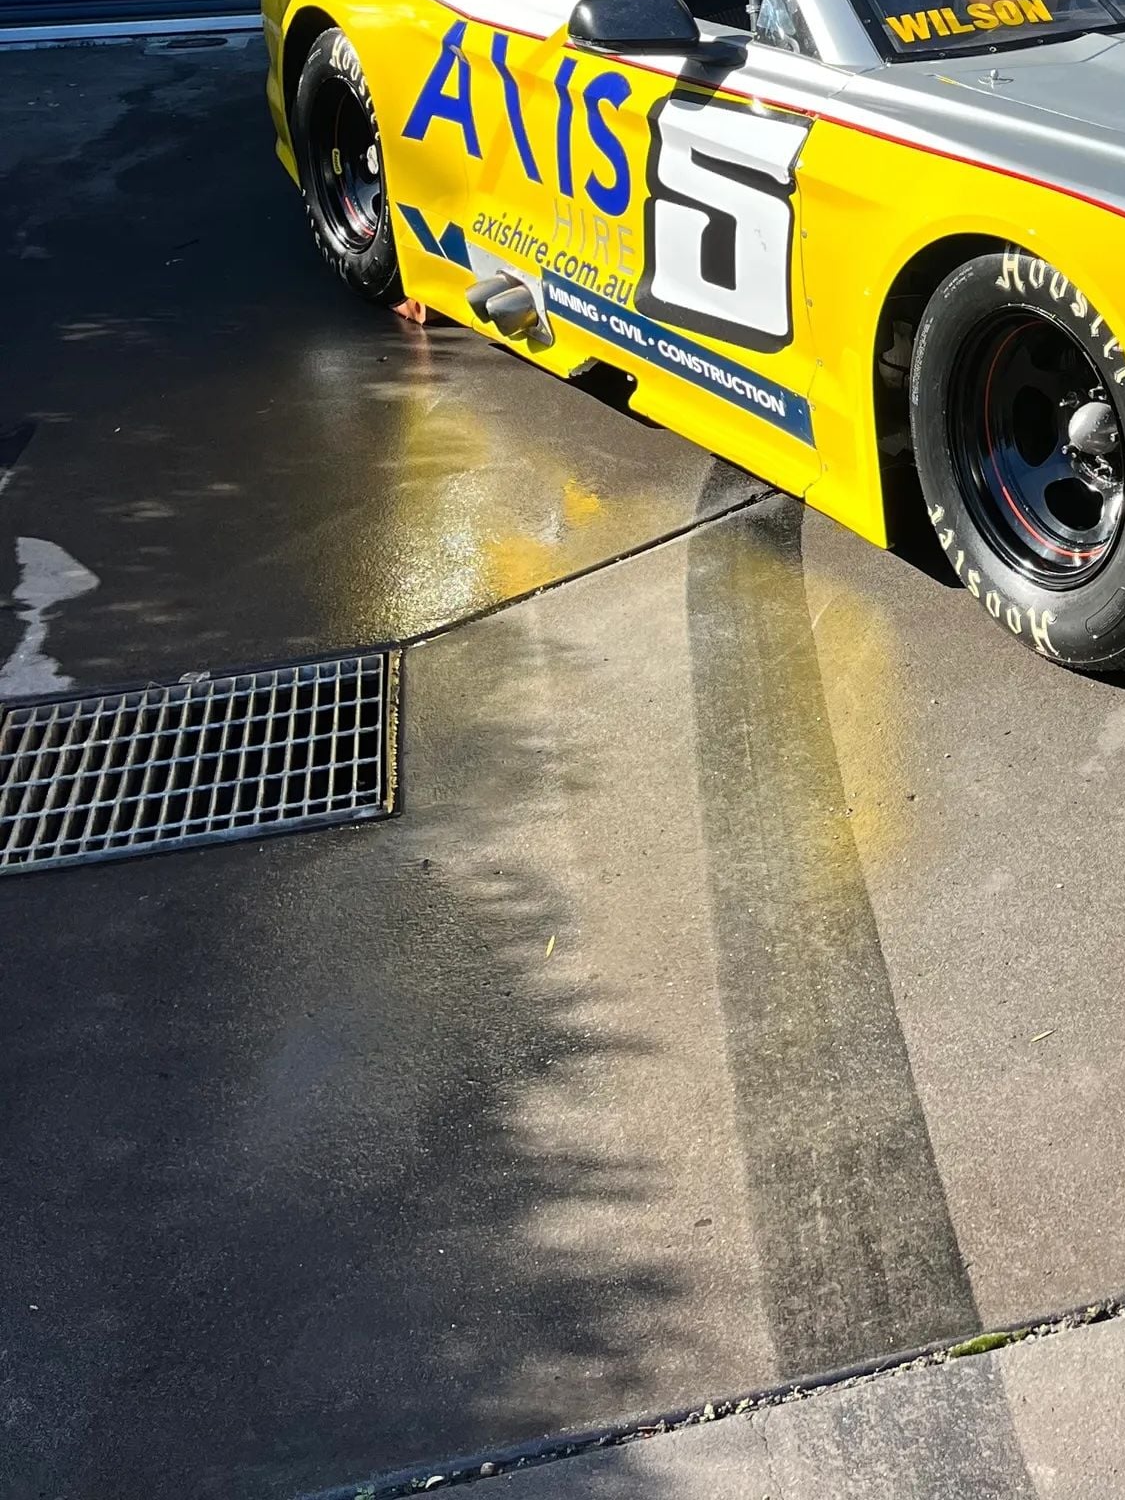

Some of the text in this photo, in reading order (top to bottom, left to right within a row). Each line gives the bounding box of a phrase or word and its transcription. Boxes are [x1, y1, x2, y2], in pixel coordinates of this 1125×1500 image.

[400, 19, 633, 217] AXIS
[472, 212, 634, 306] axishire.com.au
[552, 197, 635, 276] HIRE
[549, 284, 786, 417] MINING CIVIL CONSTRUCTION
